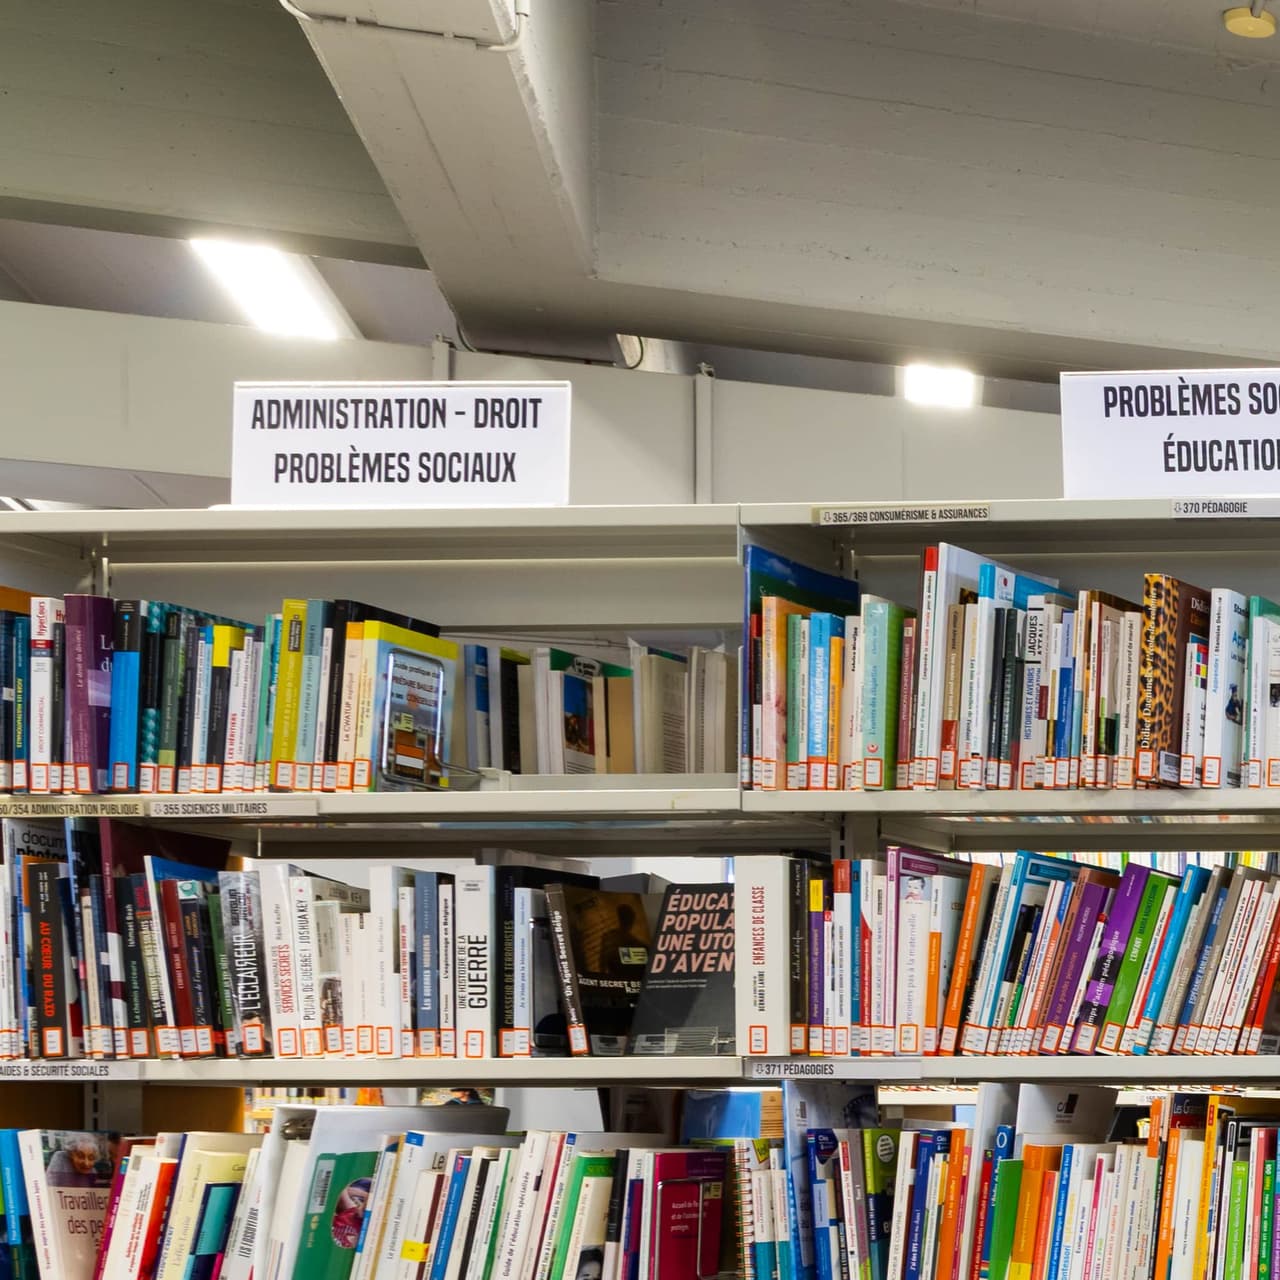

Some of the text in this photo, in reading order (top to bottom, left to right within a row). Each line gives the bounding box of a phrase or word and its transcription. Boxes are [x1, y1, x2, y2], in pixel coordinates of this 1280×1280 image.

[1104, 376, 1240, 417] PROBLÈMES
[251, 398, 447, 429] ADMINISTRATION
[474, 398, 543, 429] DROIT
[274, 445, 516, 484] PROBLÈMES SOCIAUX
[832, 508, 988, 523] 365/369 CONSUMÉRISME & ASSURANCES
[1182, 500, 1248, 514] 370 PÉDAGOGIE
[31, 804, 99, 815] ADMINISTRATION
[100, 804, 141, 816] PUBLIQUE
[163, 803, 268, 815] 355 SCIENCES MILITAIRES
[751, 885, 766, 966] ENFANCES DE CLASSE
[656, 933, 695, 951] UNE
[278, 944, 295, 1014] SERVICES SECRETS
[467, 934, 488, 1010] GUERRE
[23, 1066, 29, 1077] &
[31, 1064, 69, 1077] SÉCURITÉ
[71, 1065, 109, 1077] SOCIALES
[764, 1062, 834, 1075] 371 PÉDAGOGIES
